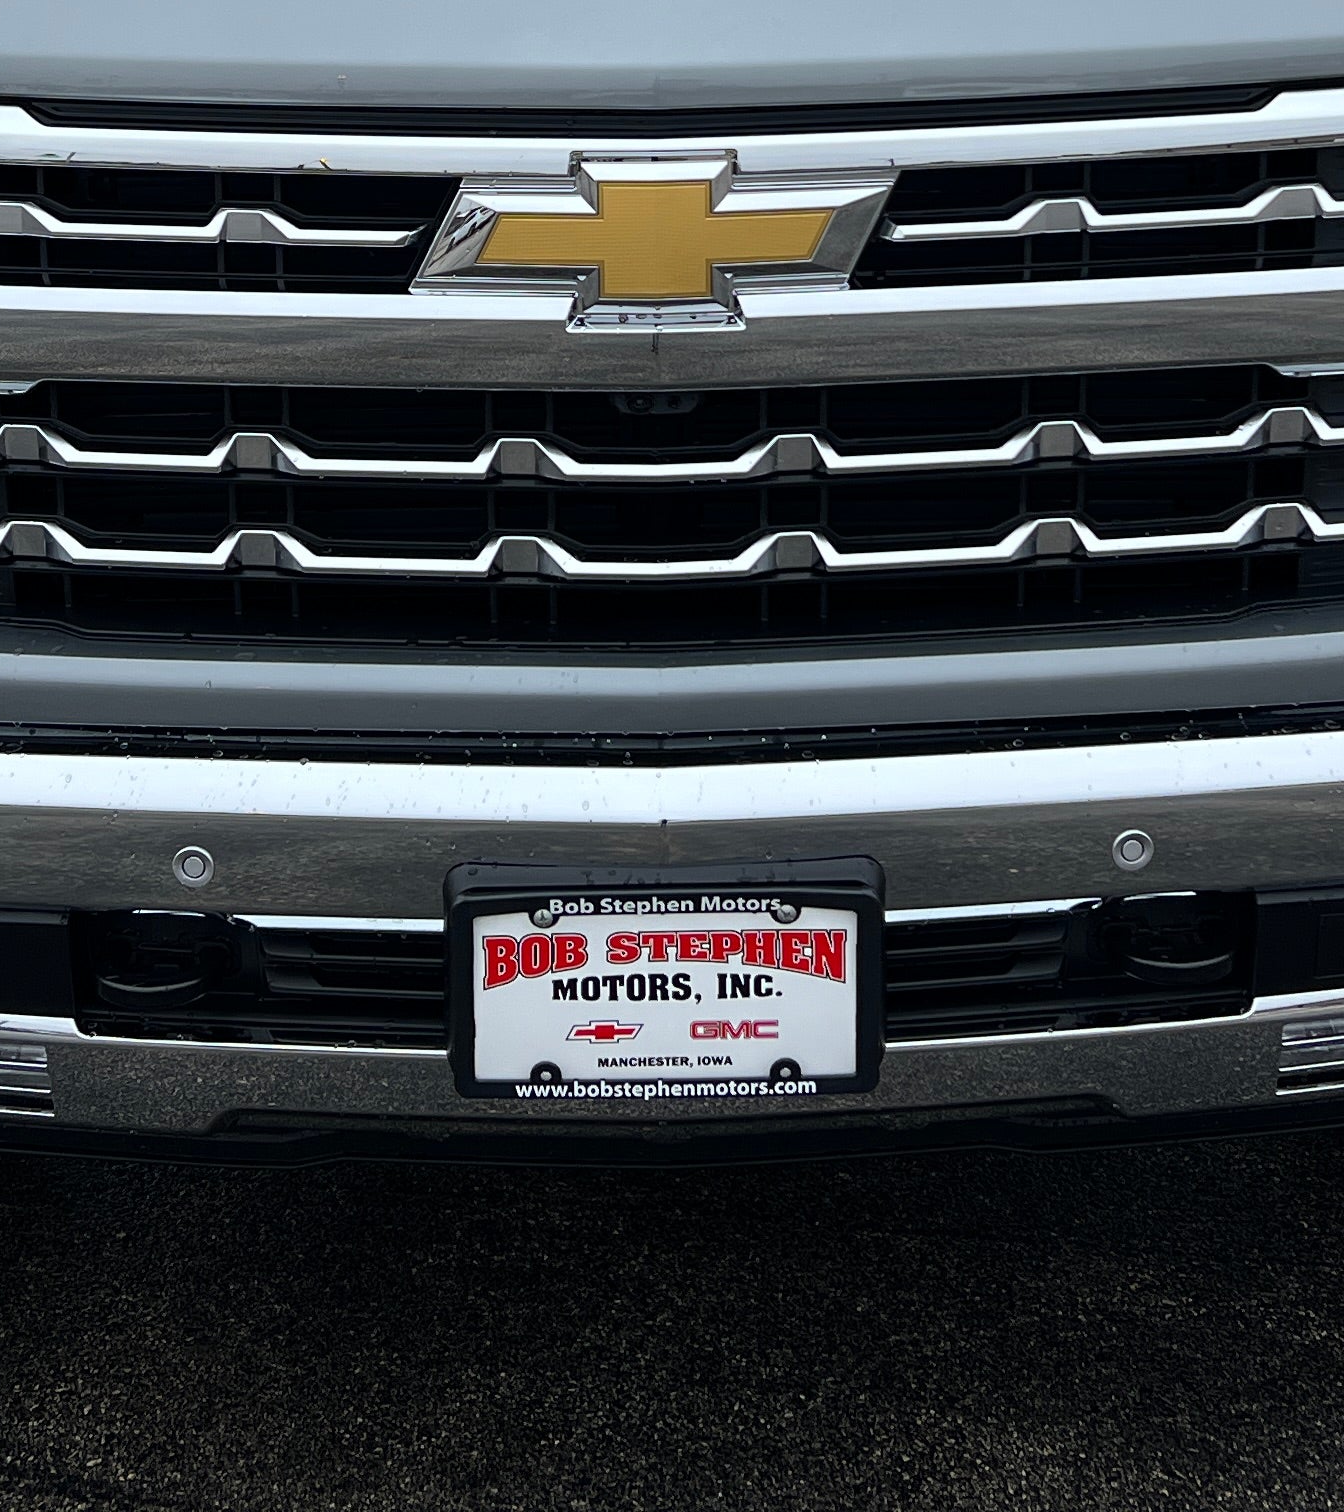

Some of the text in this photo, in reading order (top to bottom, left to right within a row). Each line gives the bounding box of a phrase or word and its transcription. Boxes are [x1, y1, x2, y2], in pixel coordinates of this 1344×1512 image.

[549, 895, 782, 916] Bob Stephen Motors
[482, 928, 848, 991] BOB STEPHEN
[551, 972, 784, 1005] MOTORS, INC.
[689, 1019, 779, 1040] GMC
[597, 1055, 734, 1069] MANCHESTER, IOWA
[515, 1079, 817, 1102] www.bobstephenmotors.com
